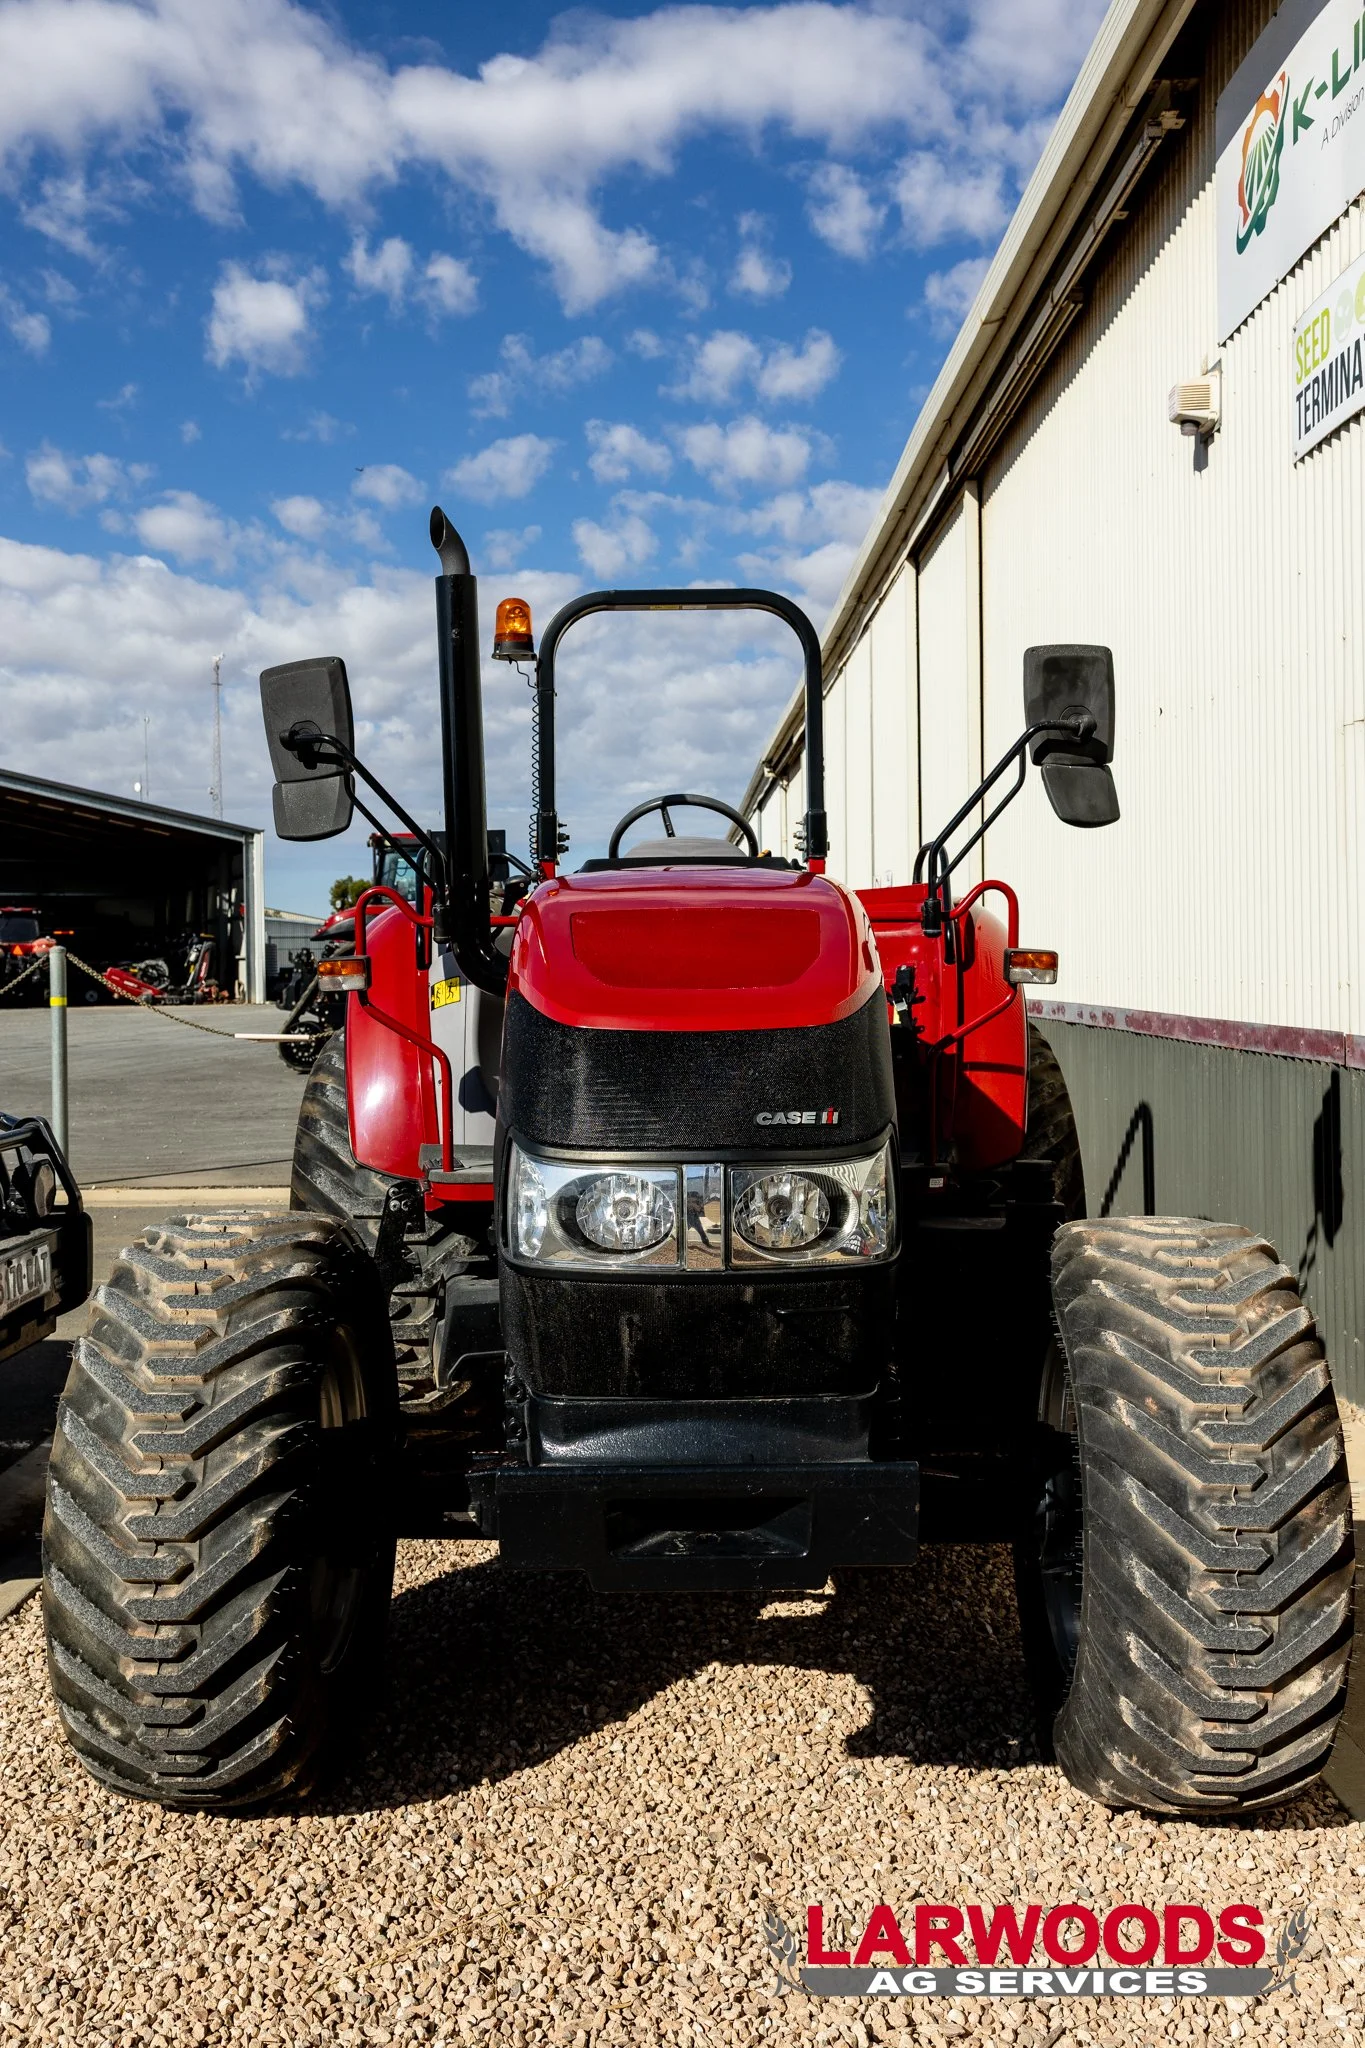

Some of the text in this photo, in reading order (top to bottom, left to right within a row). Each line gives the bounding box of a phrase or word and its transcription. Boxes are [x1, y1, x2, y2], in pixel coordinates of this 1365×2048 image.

[1293, 9, 1365, 146] K-LI
[1321, 86, 1365, 151] A Division
[1295, 307, 1331, 386] SEED
[1295, 333, 1365, 441] TERMINA
[756, 1111, 817, 1126] CASE
